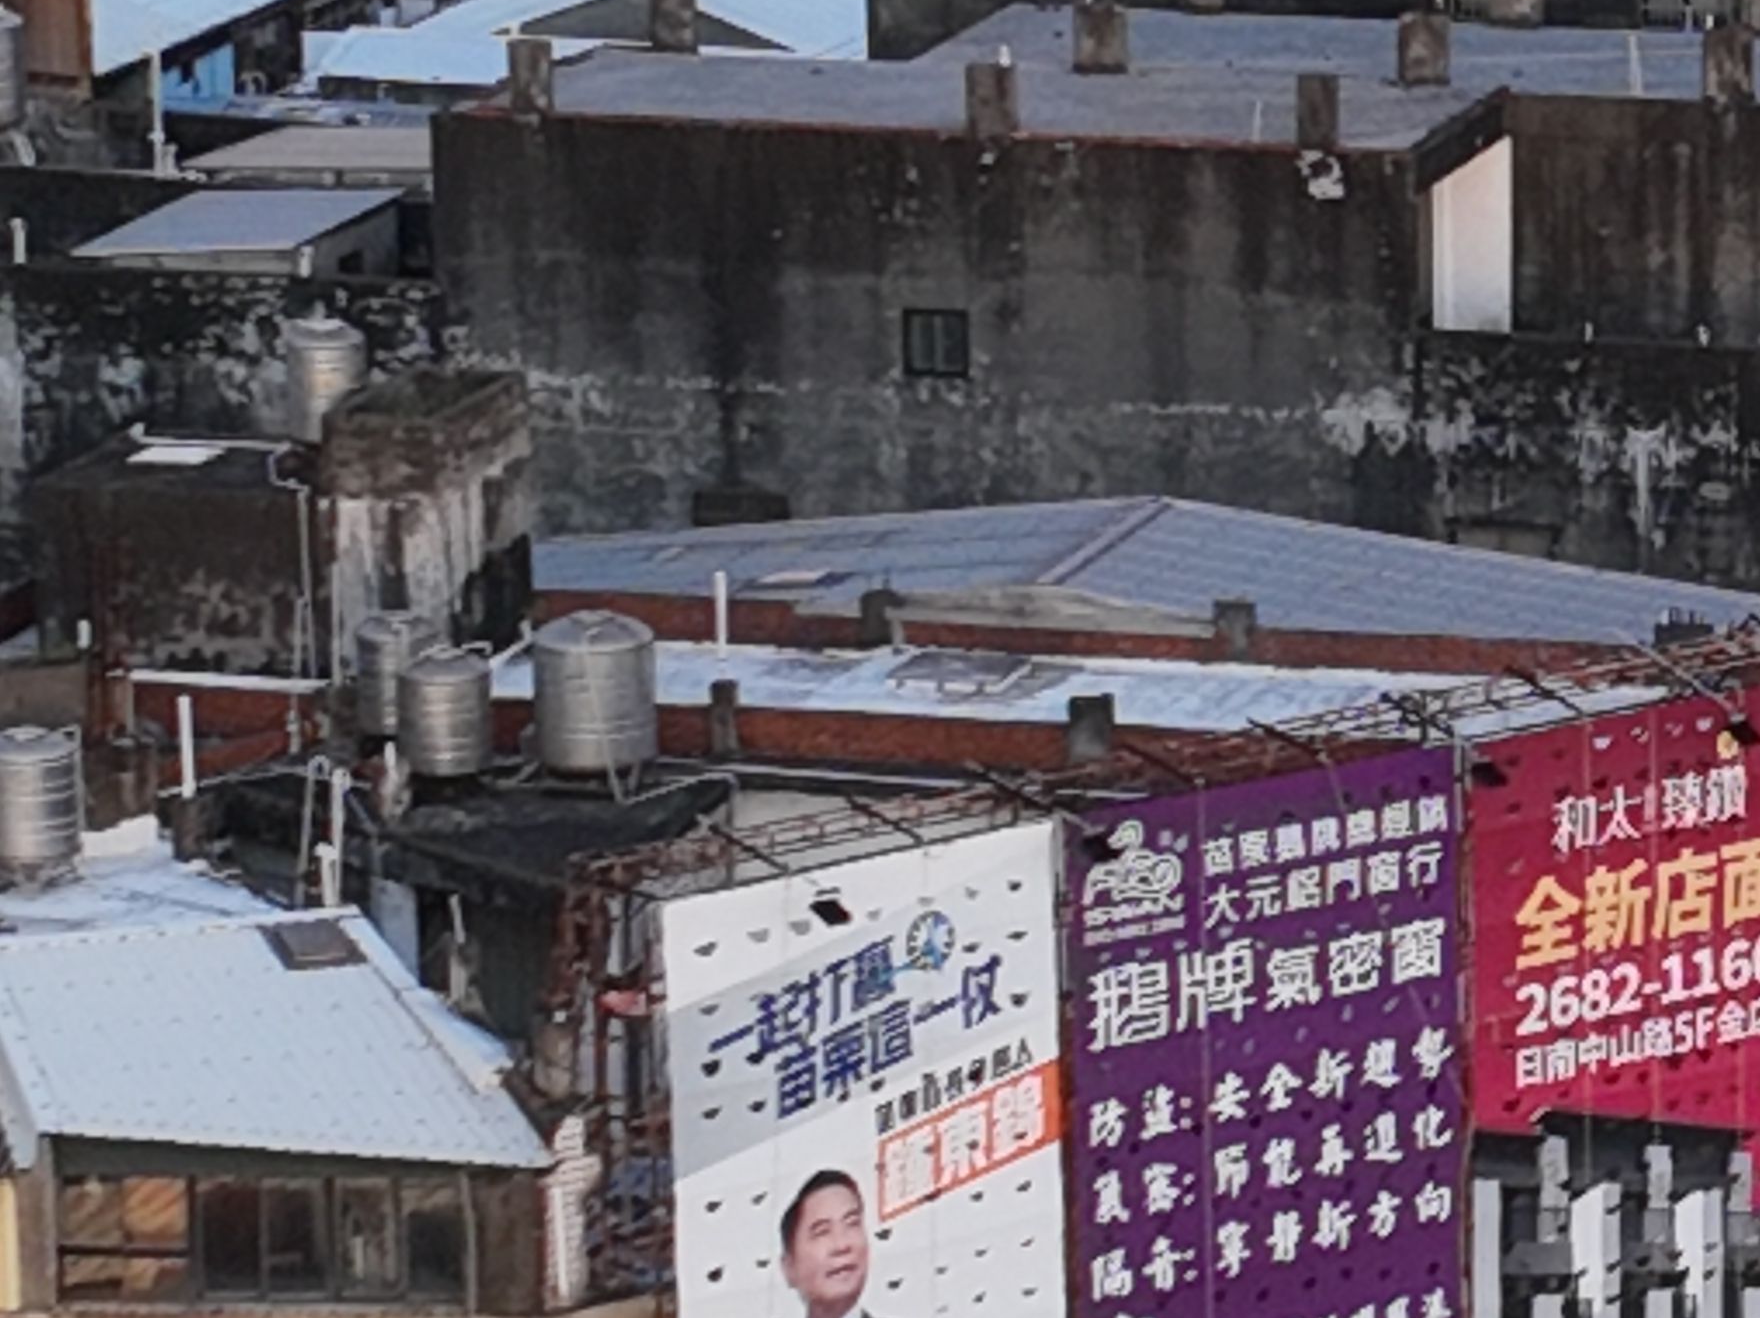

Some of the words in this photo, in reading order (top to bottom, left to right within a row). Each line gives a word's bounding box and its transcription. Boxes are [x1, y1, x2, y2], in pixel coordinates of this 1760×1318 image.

[776, 953, 1002, 1119] 苗栗這一仗
[1088, 918, 1446, 1051] 鵝牌氣密窗
